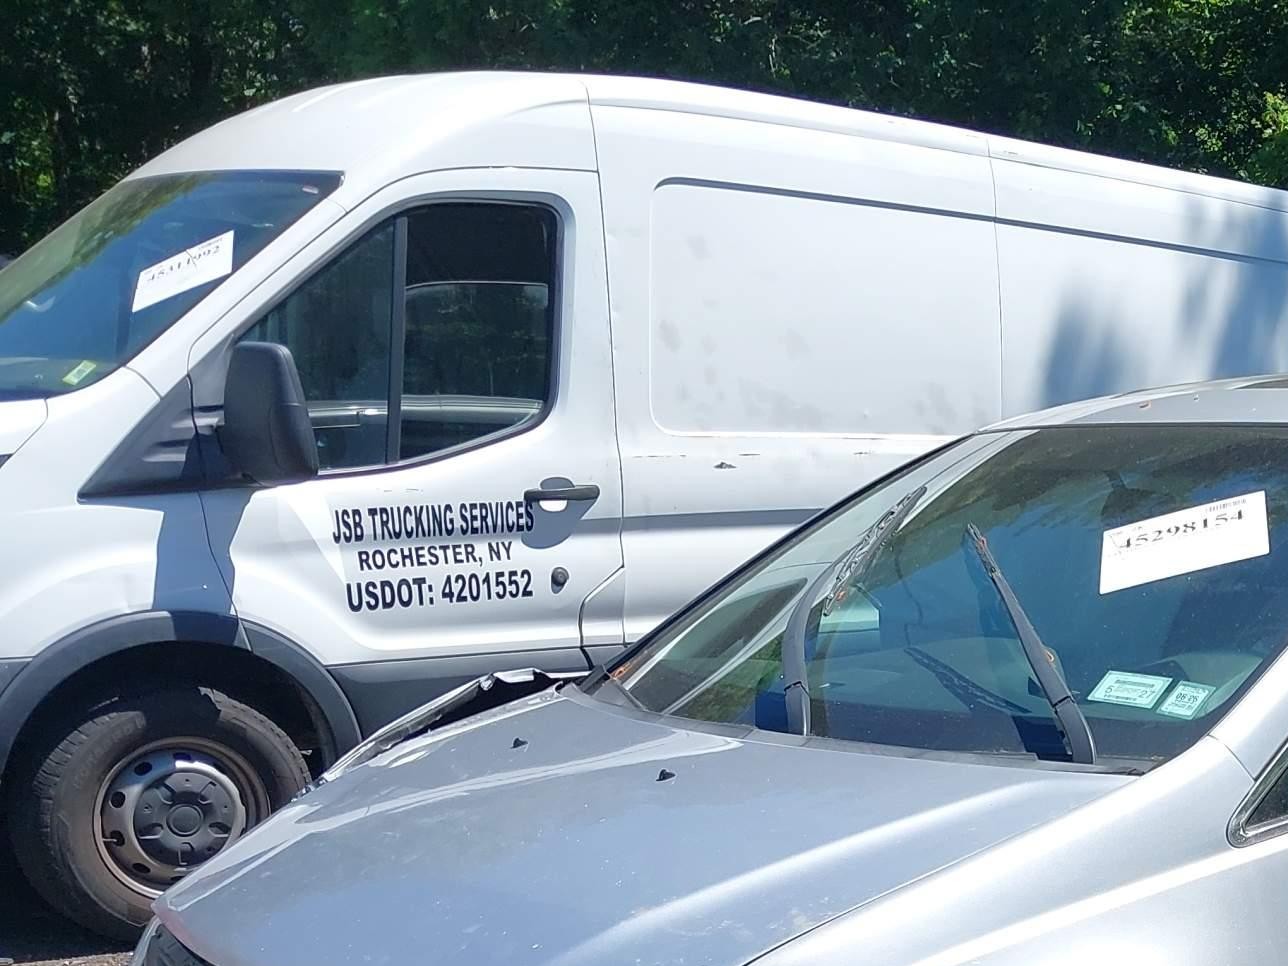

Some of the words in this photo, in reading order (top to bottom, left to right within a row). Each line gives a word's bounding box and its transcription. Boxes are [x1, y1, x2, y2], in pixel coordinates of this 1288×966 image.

[332, 508, 364, 544] JSB
[367, 503, 455, 541] TRUCKING
[459, 500, 535, 536] SERVICES
[1119, 509, 1243, 549] 45298154
[357, 543, 483, 571] ROCHESTER,
[487, 541, 513, 562] NY
[346, 577, 434, 612] USDOT:
[441, 569, 534, 604] 4201552
